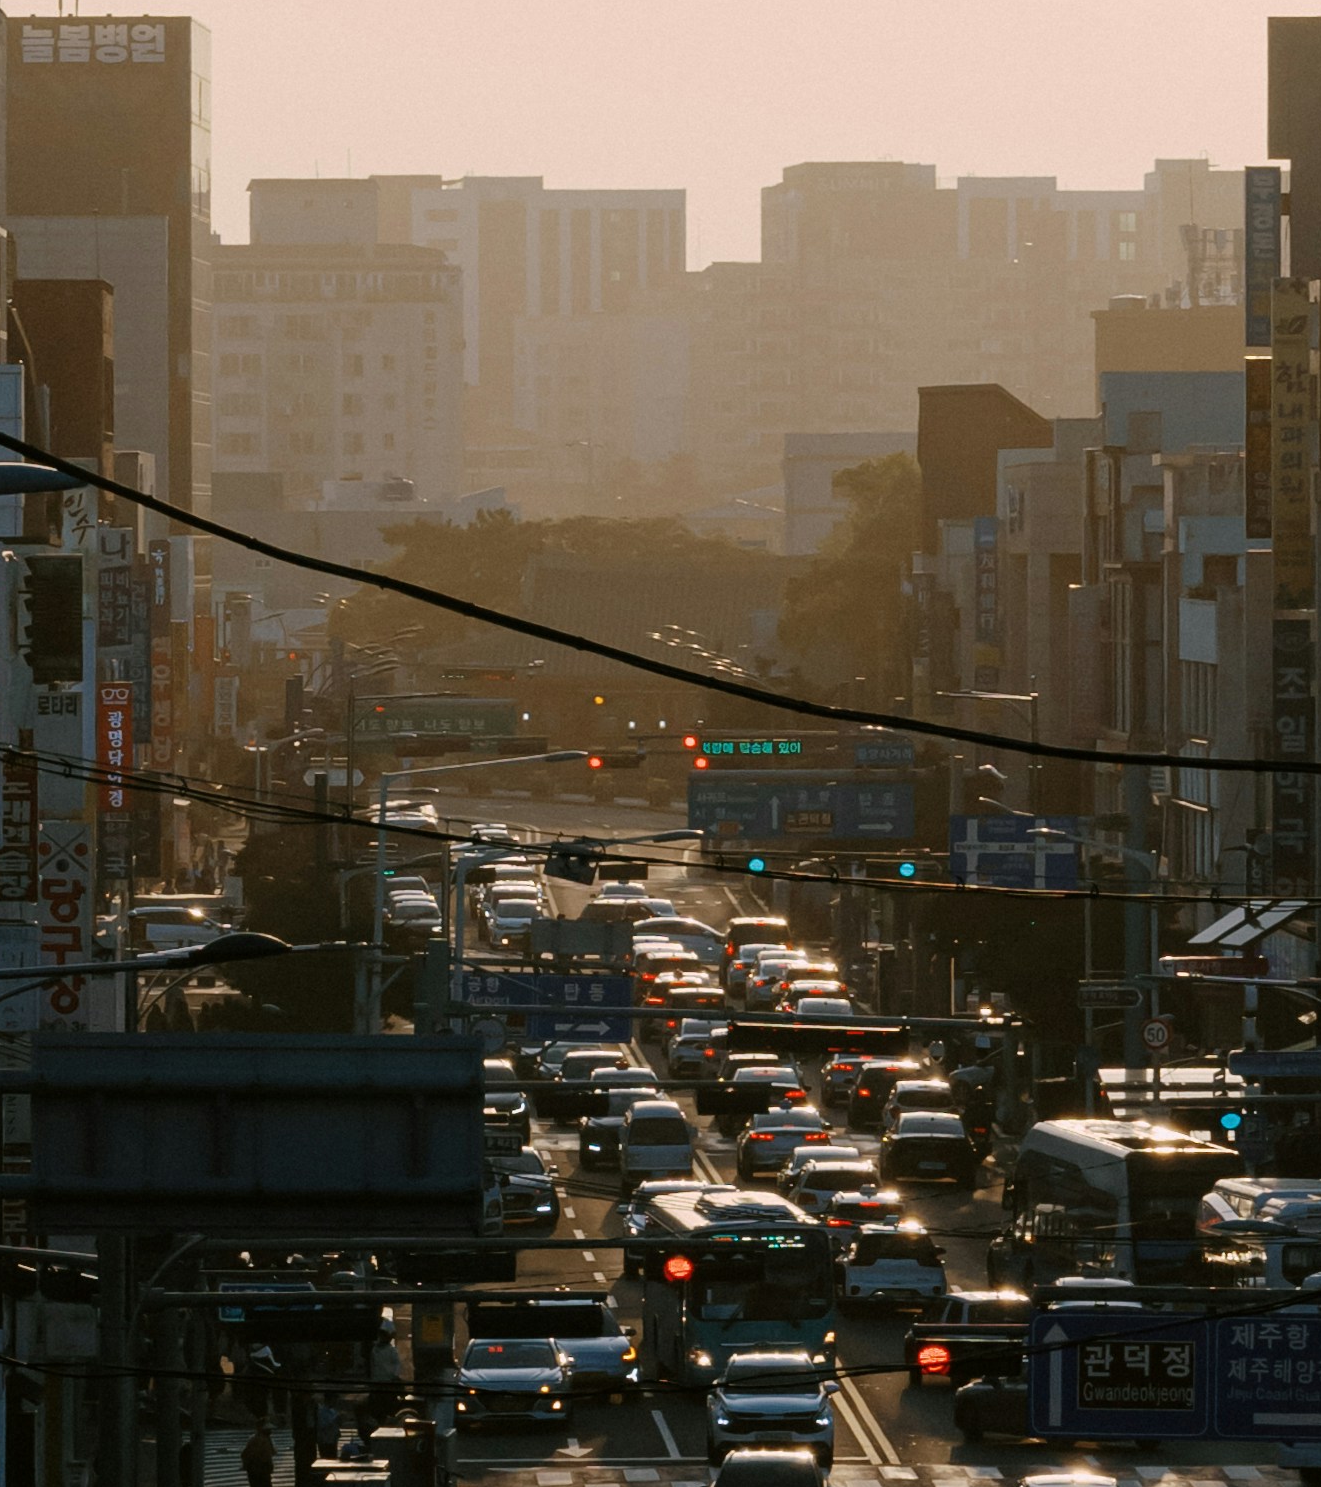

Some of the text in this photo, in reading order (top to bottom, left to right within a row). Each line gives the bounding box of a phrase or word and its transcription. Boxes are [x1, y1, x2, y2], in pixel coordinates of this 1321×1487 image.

[21, 24, 166, 64] 늘봄병원
[1146, 1026, 1165, 1043] 50
[1230, 1322, 1311, 1351] 제주항
[1083, 1343, 1193, 1378] 관덕정
[1082, 1382, 1195, 1408] Gwandeokjeong
